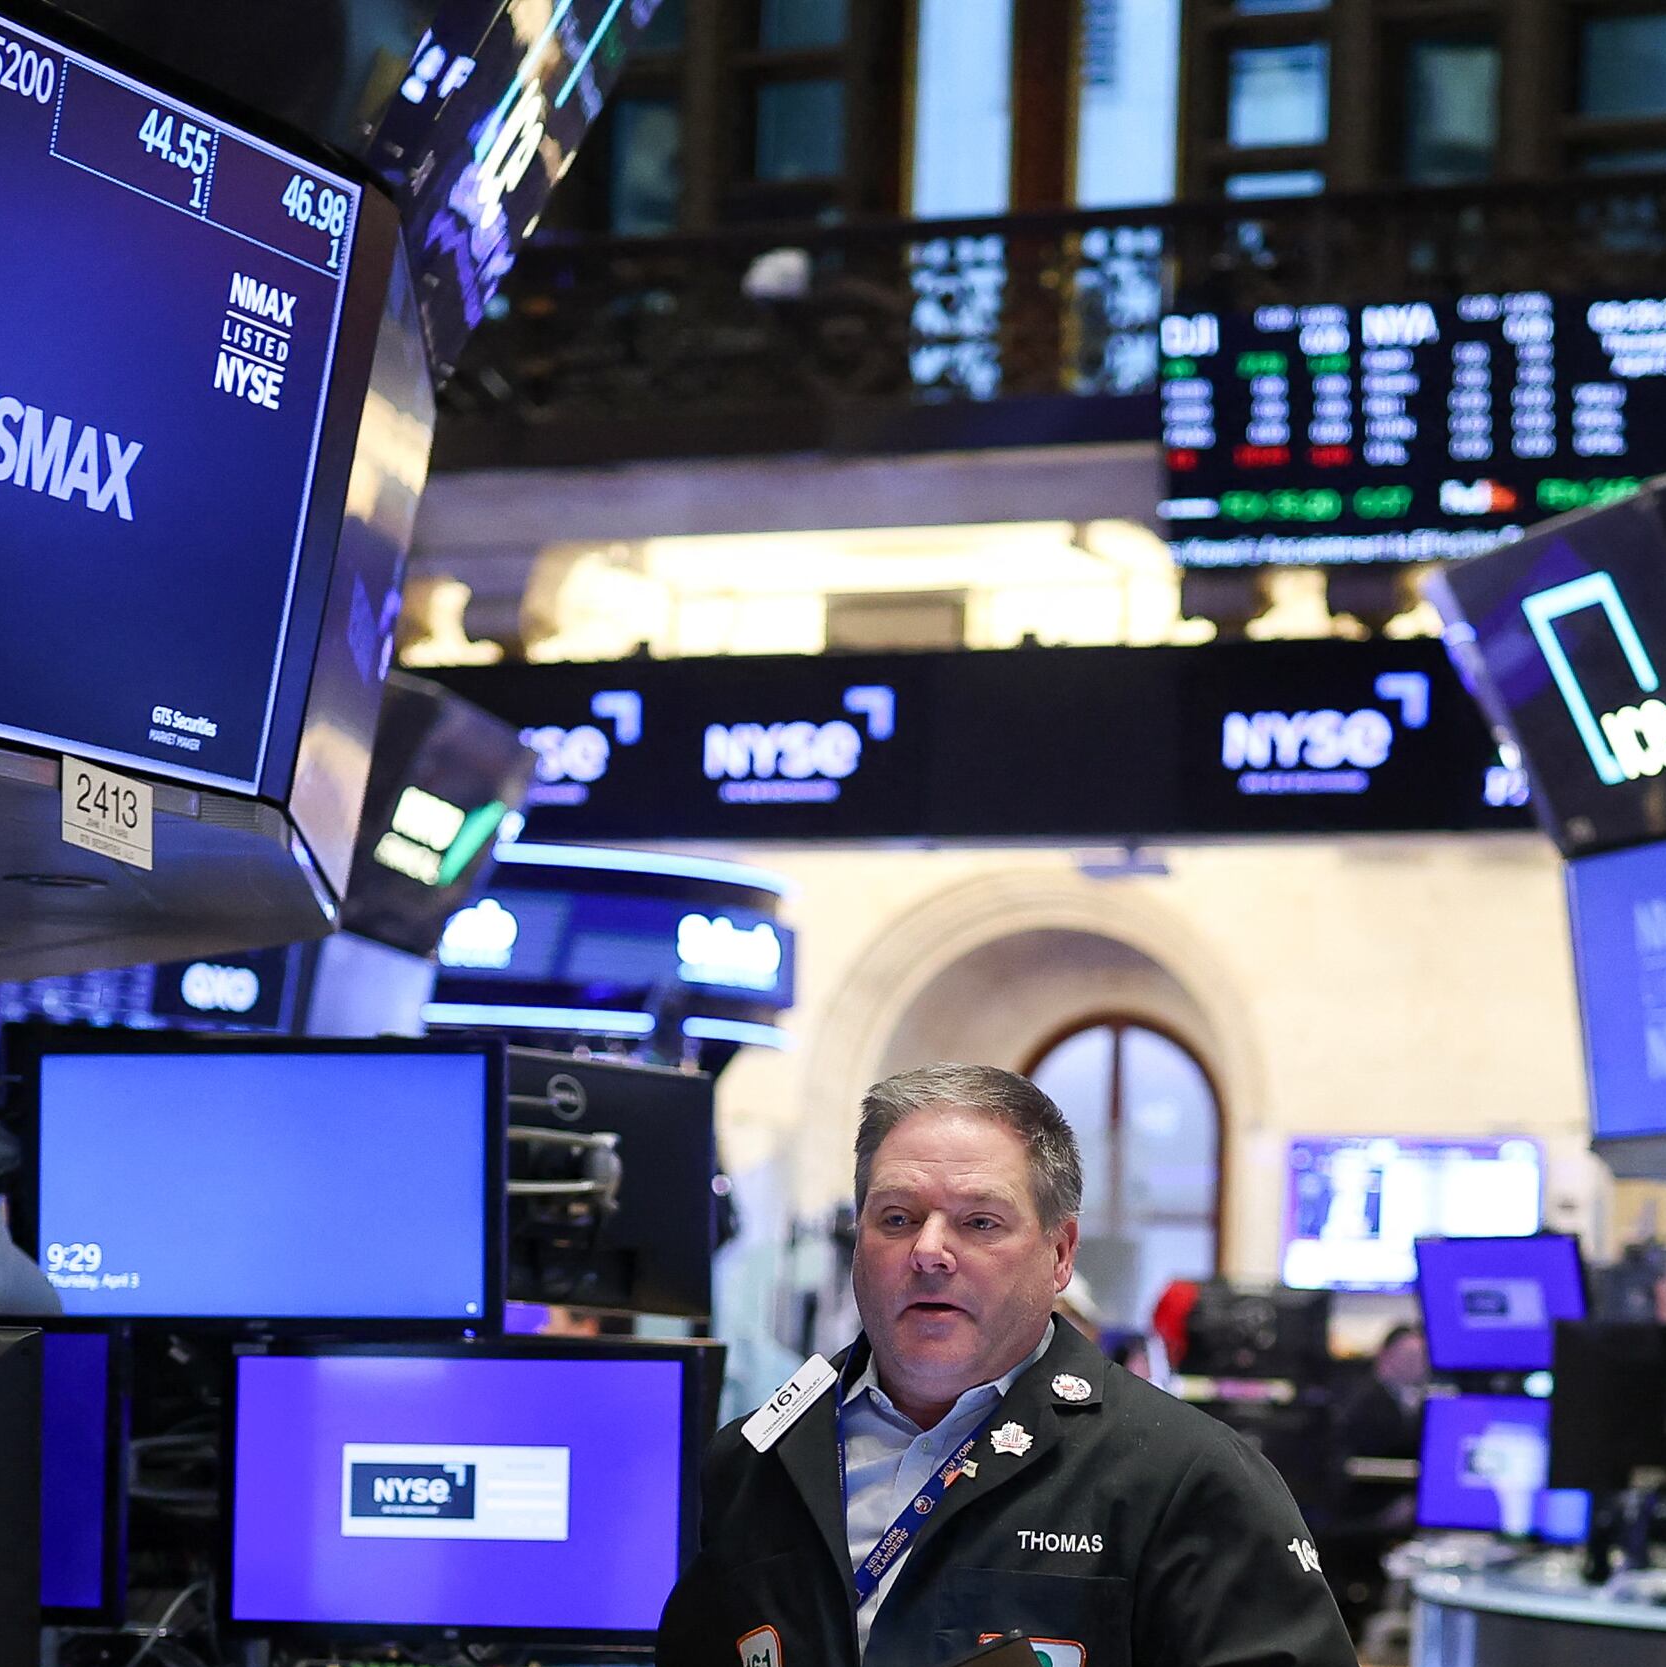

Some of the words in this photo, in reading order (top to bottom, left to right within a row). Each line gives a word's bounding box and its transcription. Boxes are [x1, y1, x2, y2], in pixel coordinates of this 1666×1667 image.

[138, 108, 212, 175] 44.55
[189, 177, 203, 209] 1
[282, 174, 348, 237] 46.98
[327, 238, 341, 269] 1
[229, 272, 297, 327] NMAX
[222, 319, 289, 362] LISTED
[214, 351, 283, 410] NYSE
[152, 706, 173, 727] GTS
[172, 711, 217, 737] Securities
[76, 773, 138, 829] 2413
[47, 1243, 102, 1272] 9:29
[767, 1382, 800, 1413] 161
[954, 1438, 976, 1460] YORK
[865, 1551, 882, 1571] NEW
[880, 1526, 901, 1551] YORK
[871, 1528, 909, 1577] ISLANDERS
[1017, 1530, 1104, 1553] THOMAS
